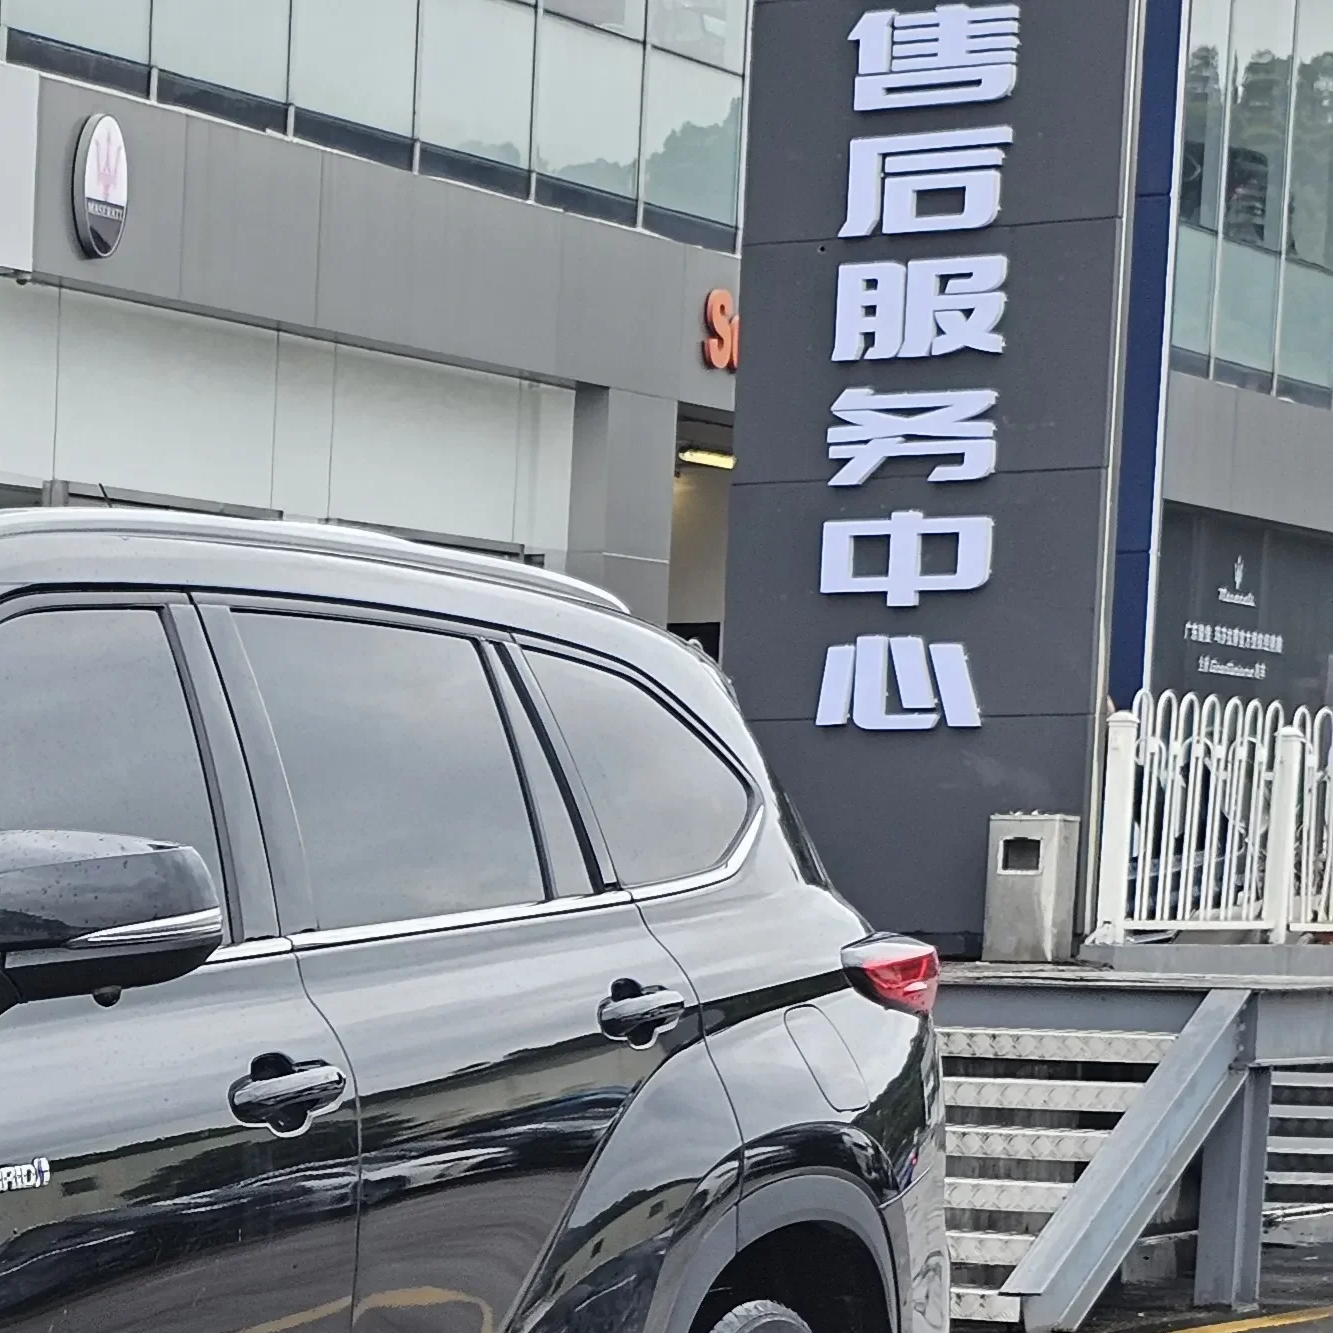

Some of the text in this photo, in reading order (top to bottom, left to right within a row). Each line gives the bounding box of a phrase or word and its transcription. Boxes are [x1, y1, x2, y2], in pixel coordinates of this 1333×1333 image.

[815, 3, 1020, 731] 售后服务中心
